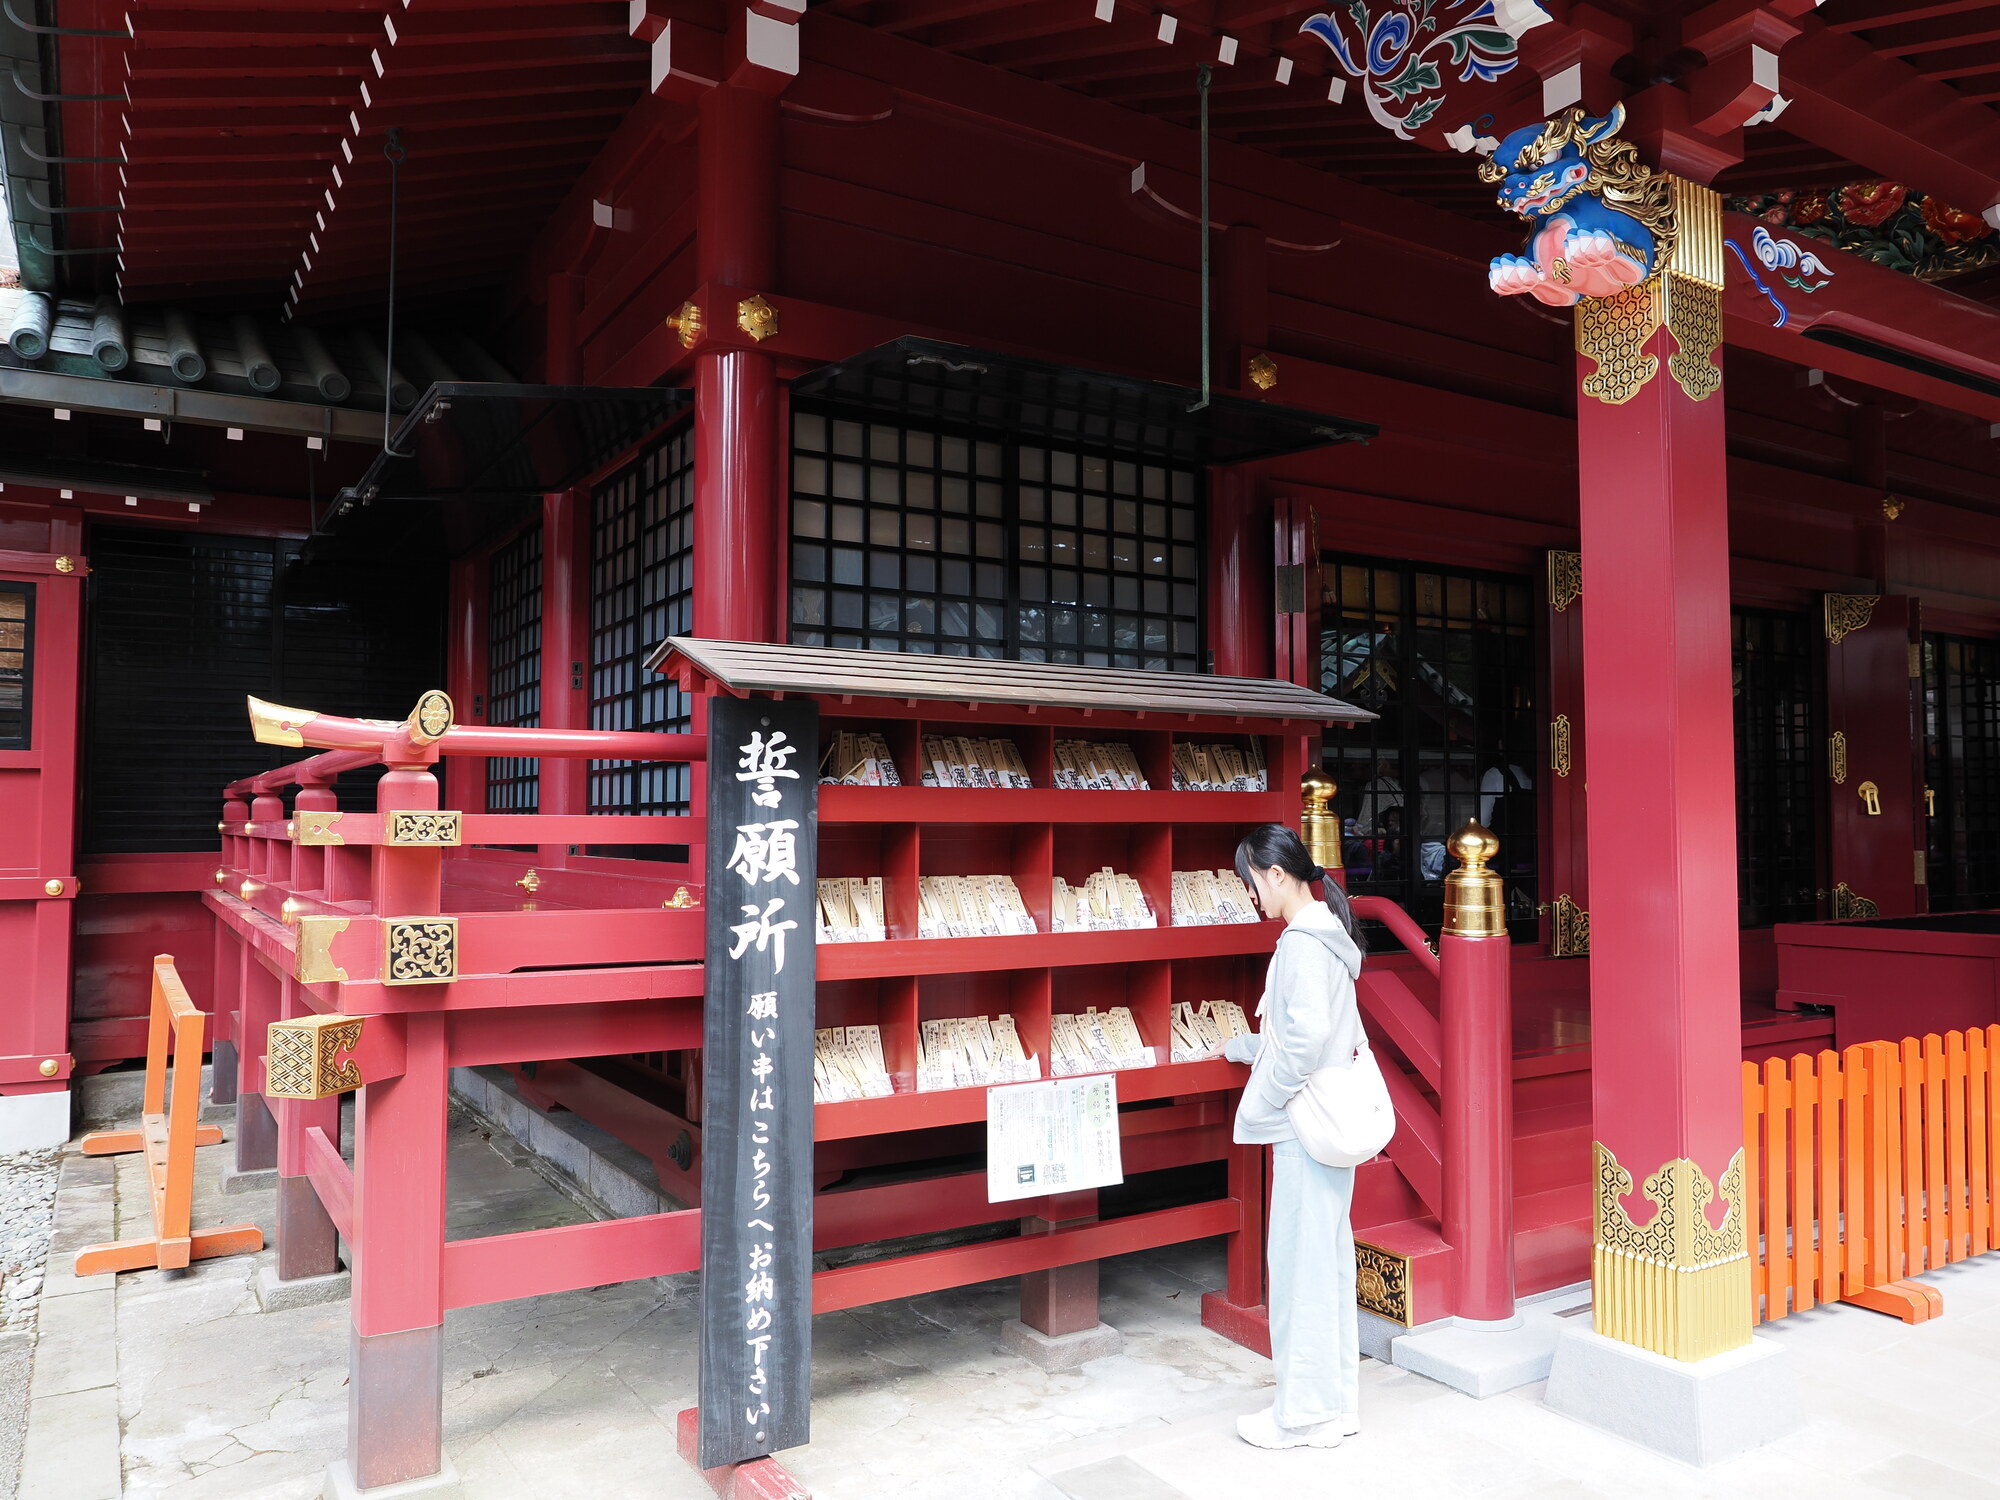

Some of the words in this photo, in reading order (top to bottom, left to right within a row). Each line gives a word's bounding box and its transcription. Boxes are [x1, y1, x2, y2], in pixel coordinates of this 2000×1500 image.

[725, 731, 801, 976] 誓願所
[744, 990, 779, 1426] 願い串はこちらへお納め下さい
